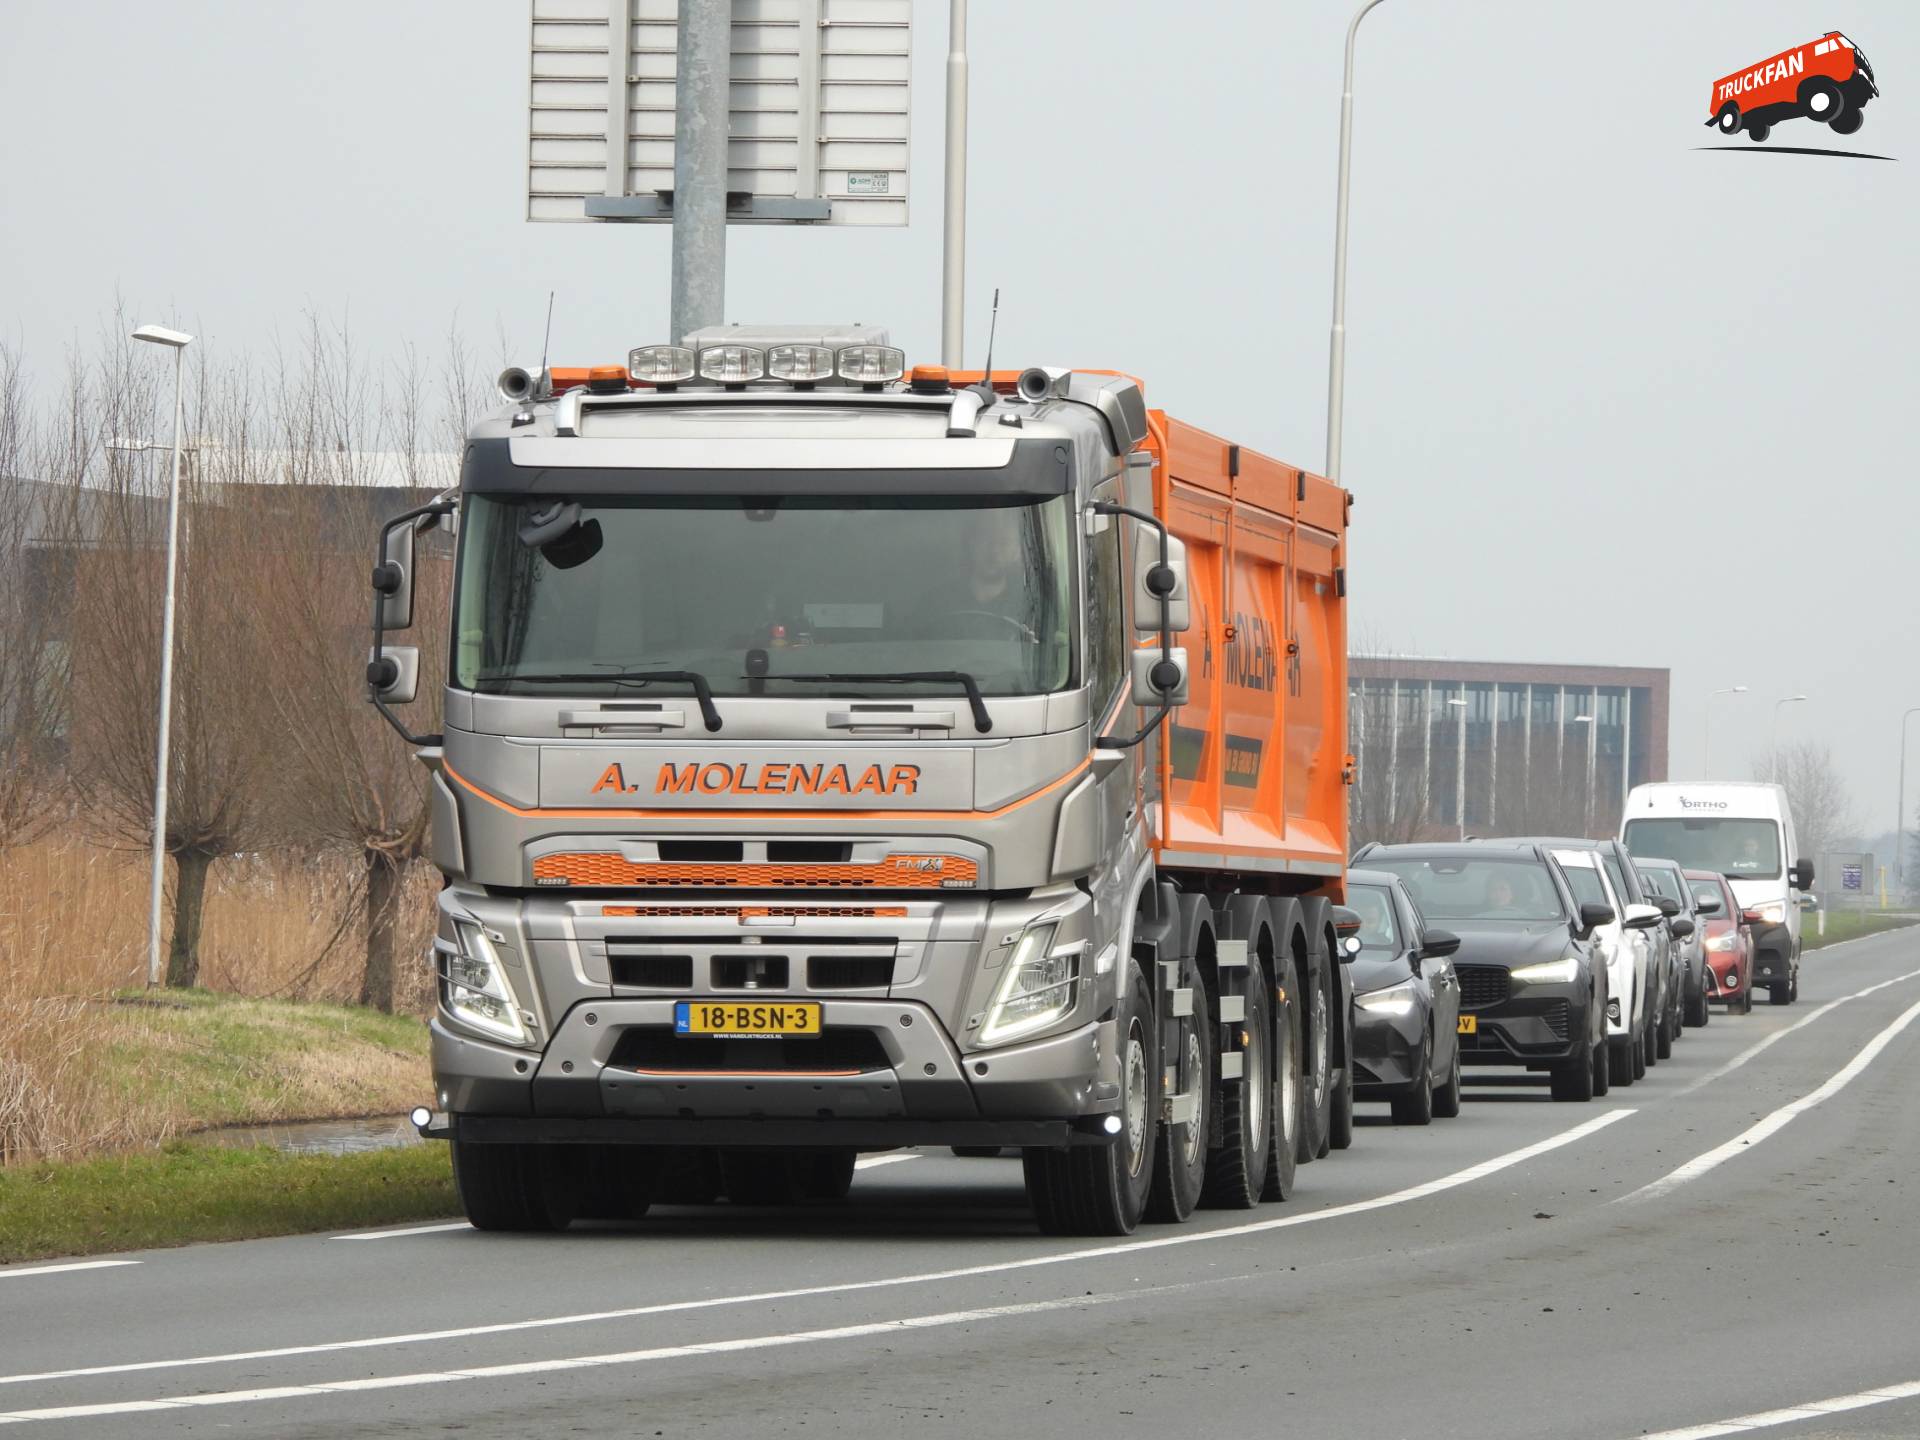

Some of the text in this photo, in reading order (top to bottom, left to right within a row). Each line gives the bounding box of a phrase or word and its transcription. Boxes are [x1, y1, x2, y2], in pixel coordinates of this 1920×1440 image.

[591, 762, 921, 795] A. MOLENAAR
[1683, 800, 1728, 809] ORTHO
[678, 1020, 688, 1028] NL
[701, 1007, 808, 1029] 18-BSN-3
